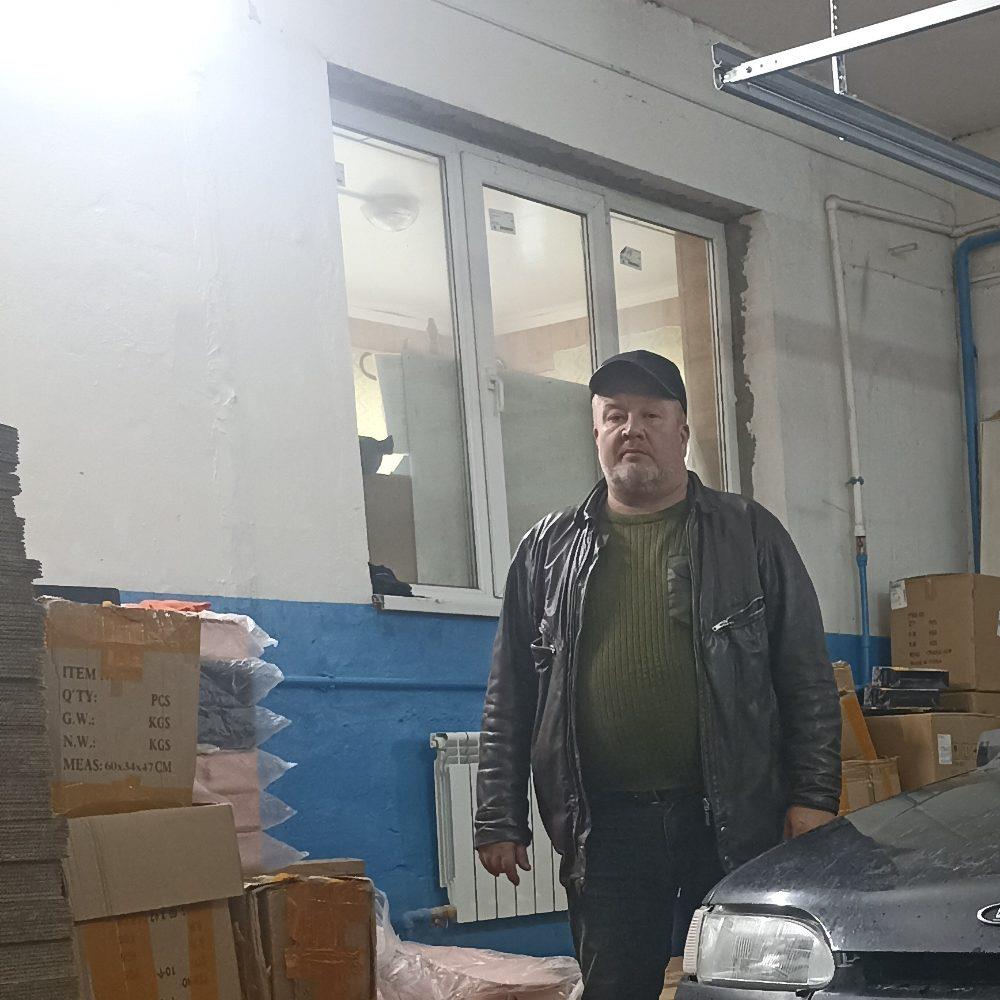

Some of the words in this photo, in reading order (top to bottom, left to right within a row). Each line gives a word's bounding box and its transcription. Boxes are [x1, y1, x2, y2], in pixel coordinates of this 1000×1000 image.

[62, 665, 97, 681] ITEM
[62, 688, 98, 703] Q'TY:
[150, 693, 172, 708] PCS
[148, 716, 171, 730] KGS
[148, 738, 172, 752] KGS
